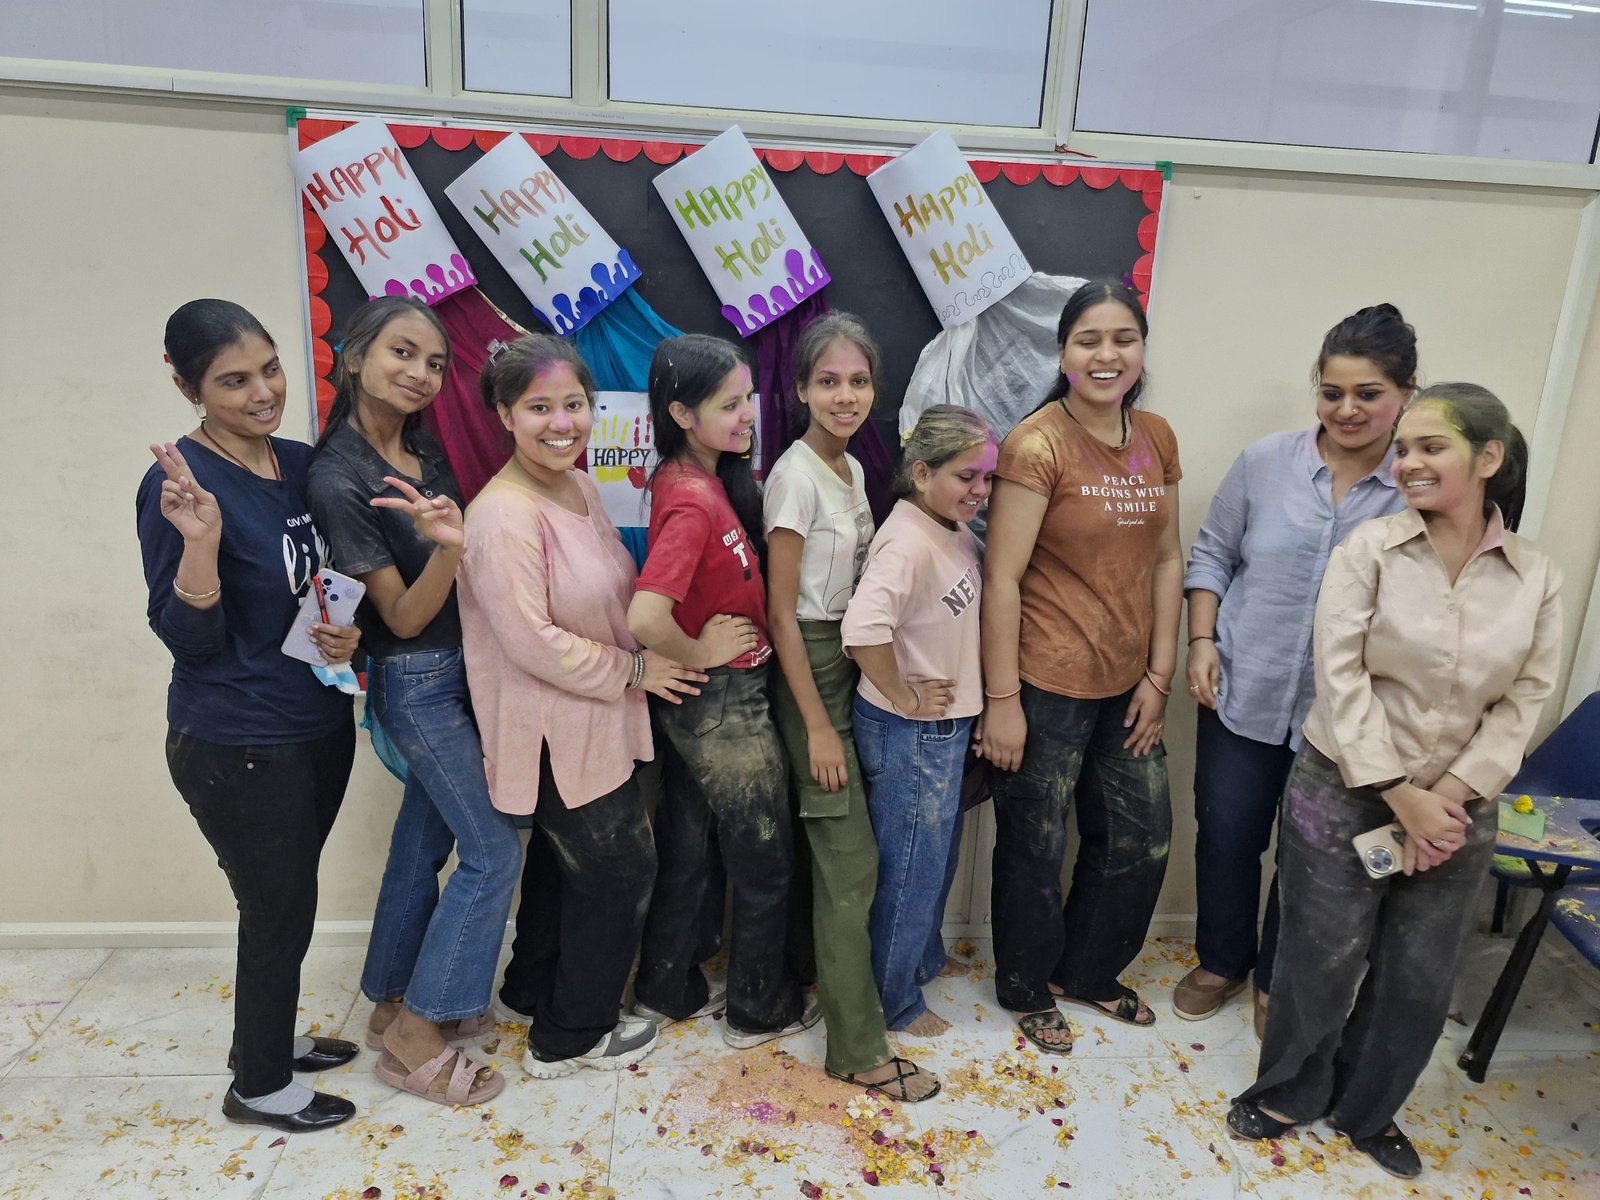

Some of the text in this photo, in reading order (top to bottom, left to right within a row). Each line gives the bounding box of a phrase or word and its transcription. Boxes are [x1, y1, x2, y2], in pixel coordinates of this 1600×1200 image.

[306, 147, 407, 211] HAPPY
[341, 195, 422, 265] Holi
[519, 213, 590, 284] Holi
[714, 217, 786, 281] Holi
[929, 222, 995, 285] Holi
[592, 447, 650, 467] HAPPY
[1103, 475, 1145, 486] PEACE
[1081, 486, 1165, 499] BEGINS WITH
[1104, 501, 1157, 513] A SMILE
